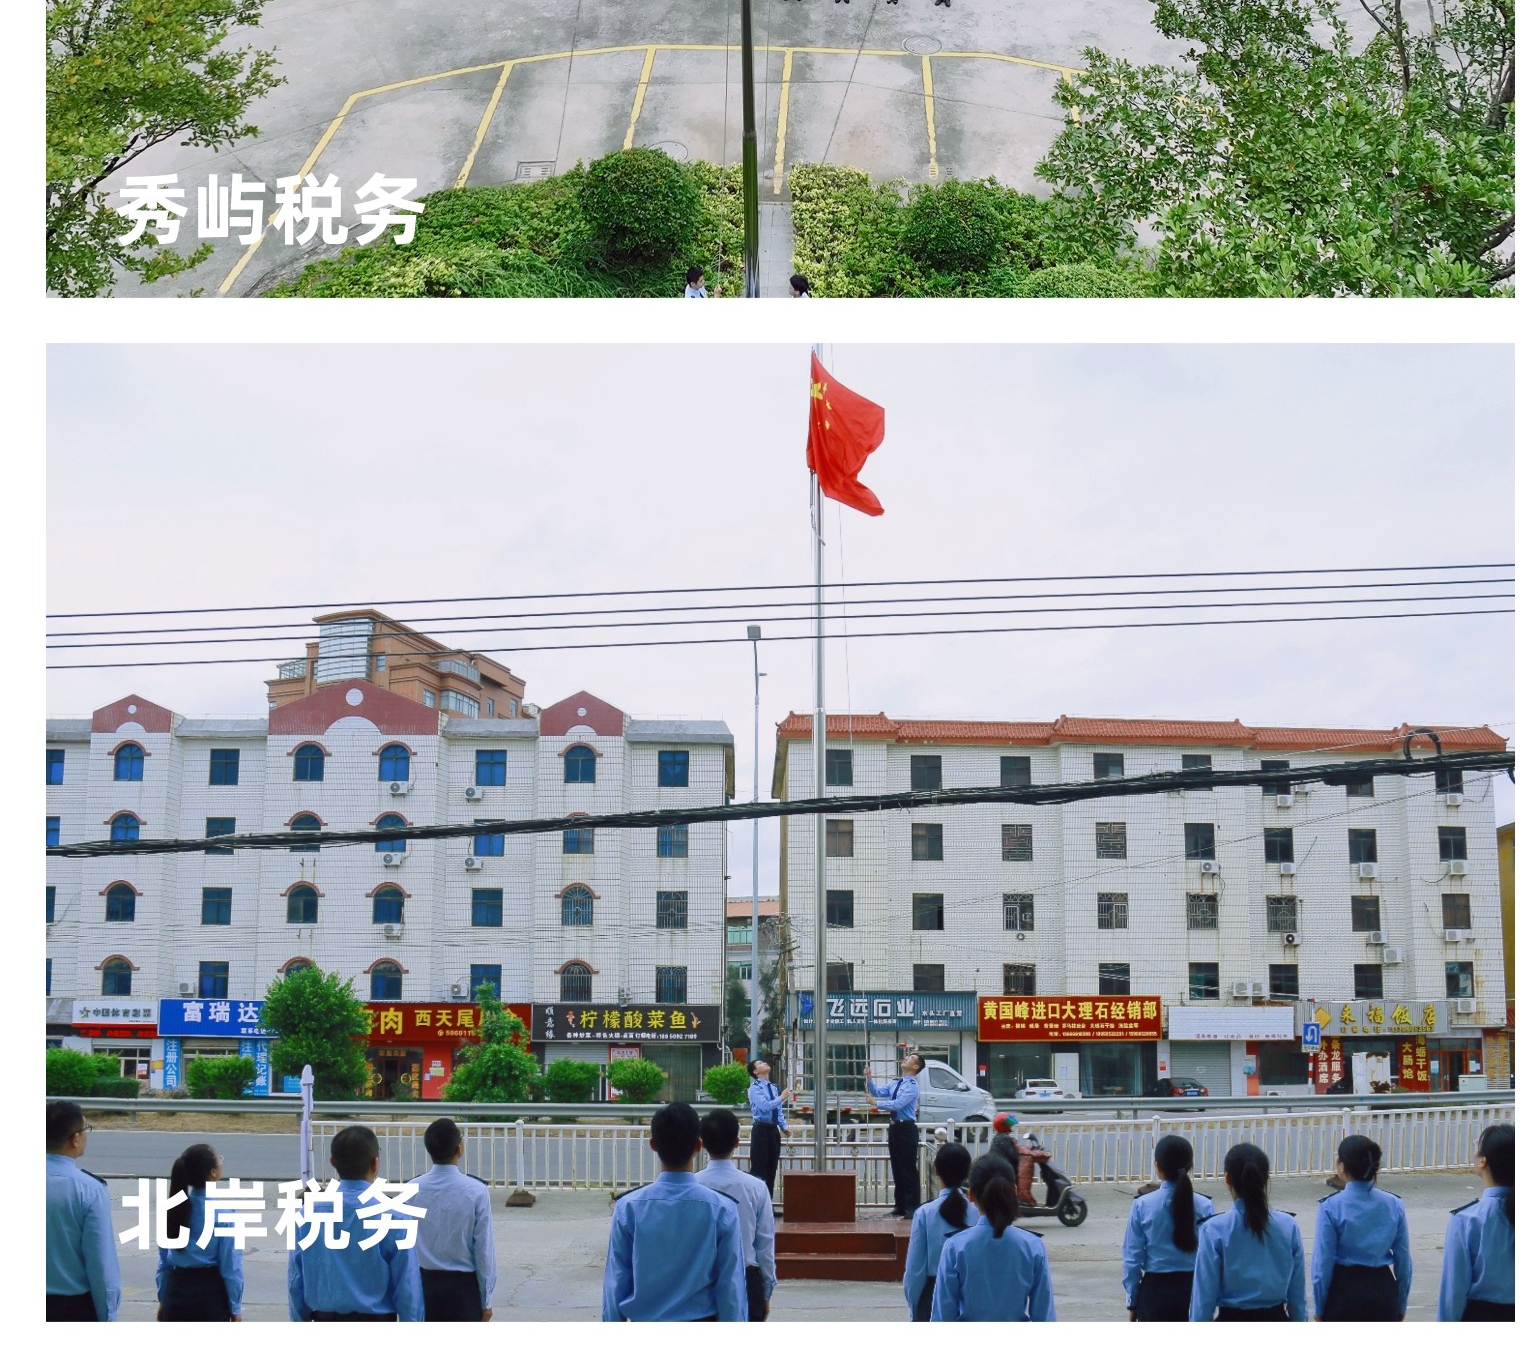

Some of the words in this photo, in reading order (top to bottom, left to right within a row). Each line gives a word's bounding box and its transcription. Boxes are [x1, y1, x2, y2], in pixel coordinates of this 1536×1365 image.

[182, 1001, 259, 1023] 富瑞达
[826, 998, 915, 1017] 飞远石业
[983, 1001, 1157, 1020] 黄国峰进口大理石经销部
[1340, 1004, 1437, 1025] 来福饭店
[580, 1010, 688, 1029] 柠檬酸菜鱼
[166, 1040, 179, 1088] 注册公司
[256, 1040, 268, 1087] 代理记账
